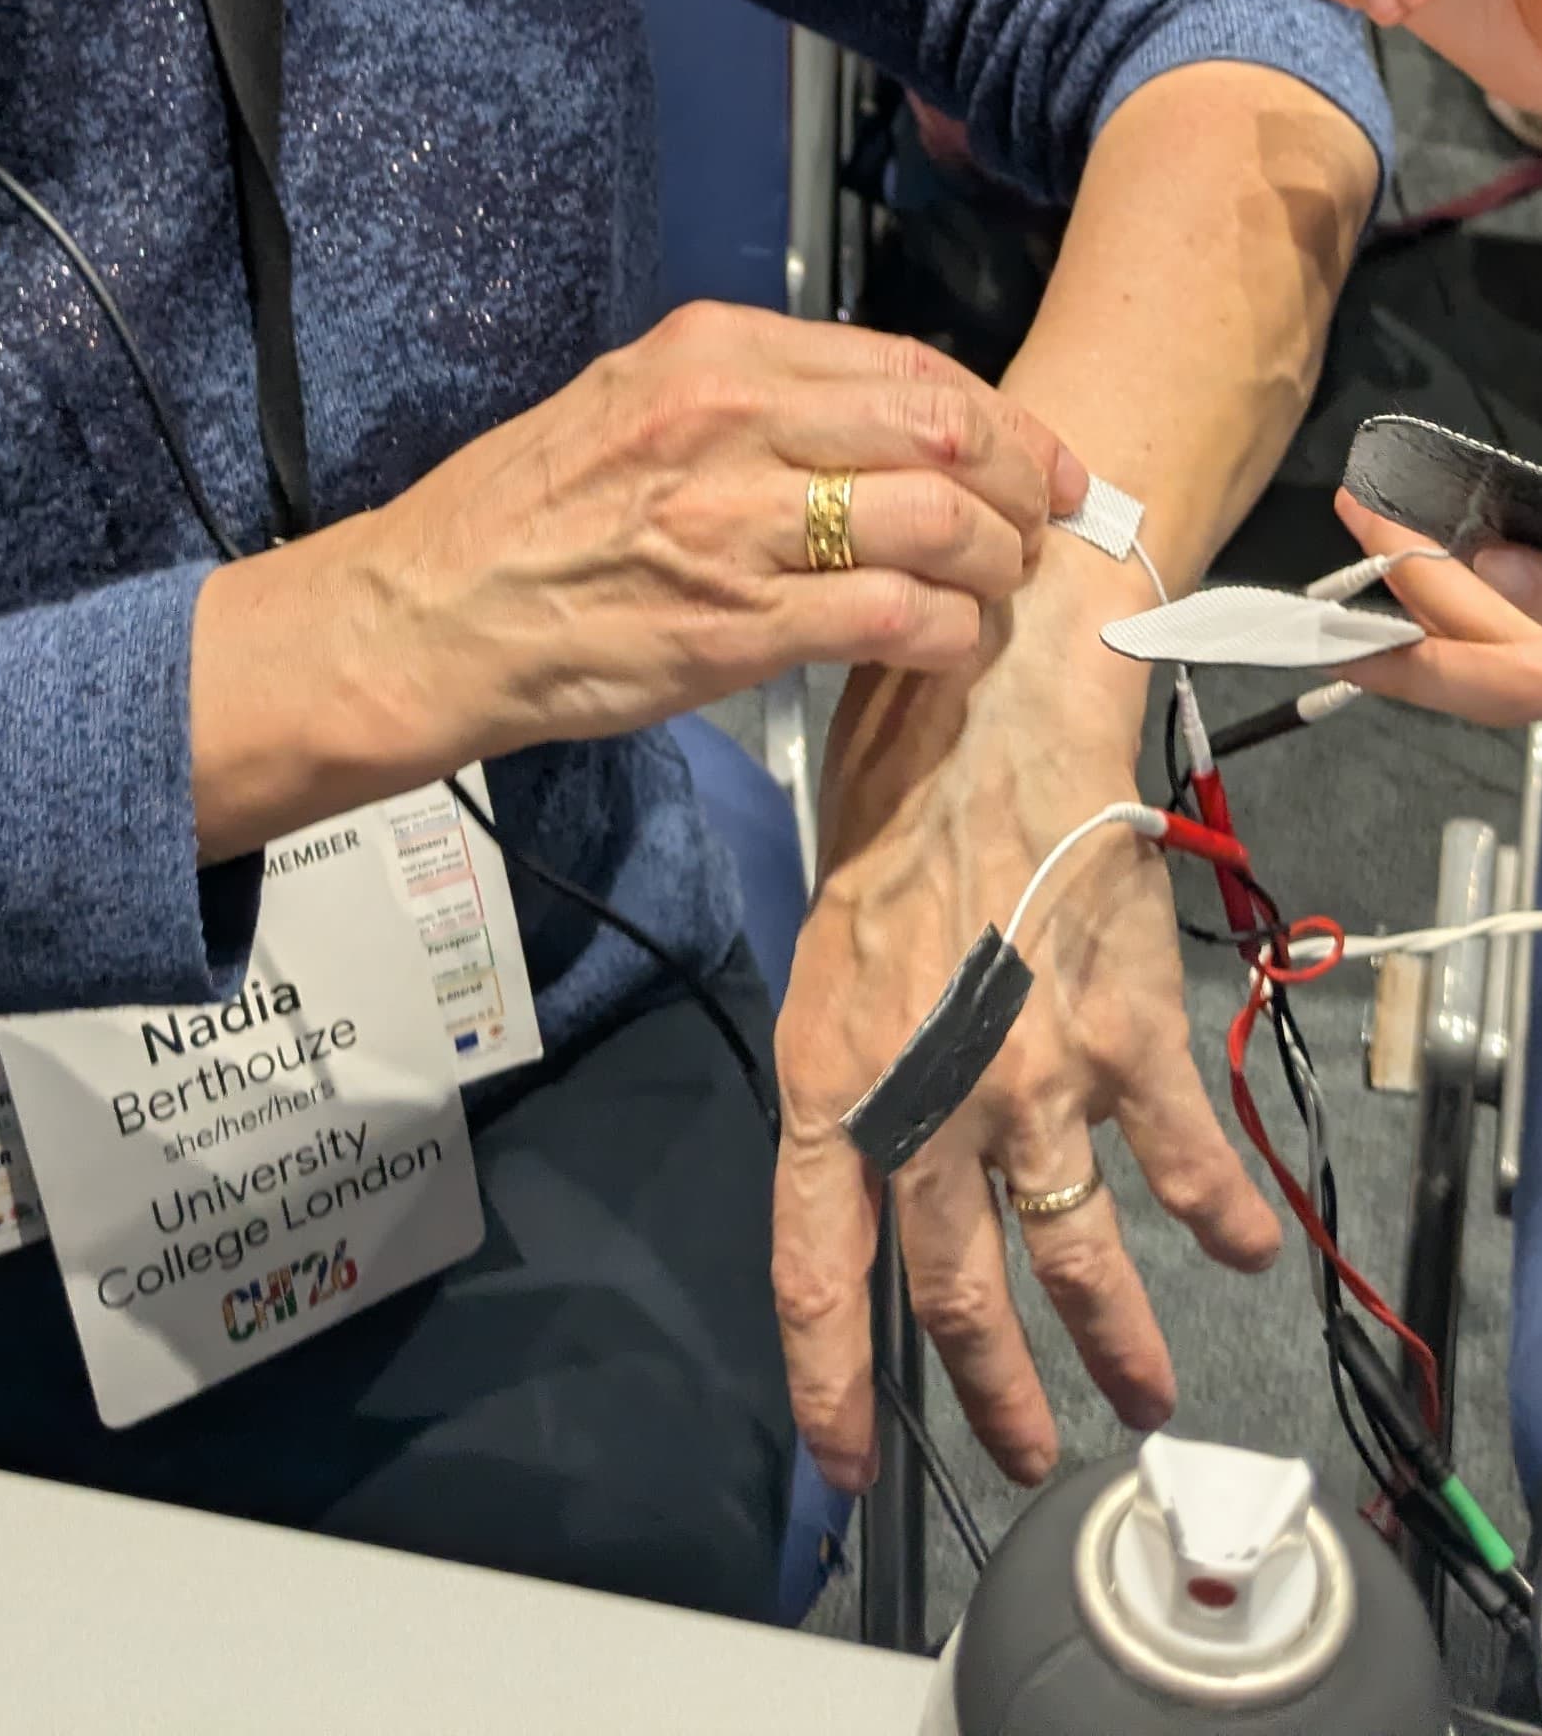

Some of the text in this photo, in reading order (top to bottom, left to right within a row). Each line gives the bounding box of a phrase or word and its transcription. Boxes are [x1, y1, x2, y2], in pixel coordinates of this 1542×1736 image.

[112, 1018, 357, 1137] Berthouze
[141, 980, 302, 1065] Nadia
[163, 1079, 336, 1162] she/her/hers
[97, 1137, 443, 1309] College London
[151, 1121, 368, 1235] University
